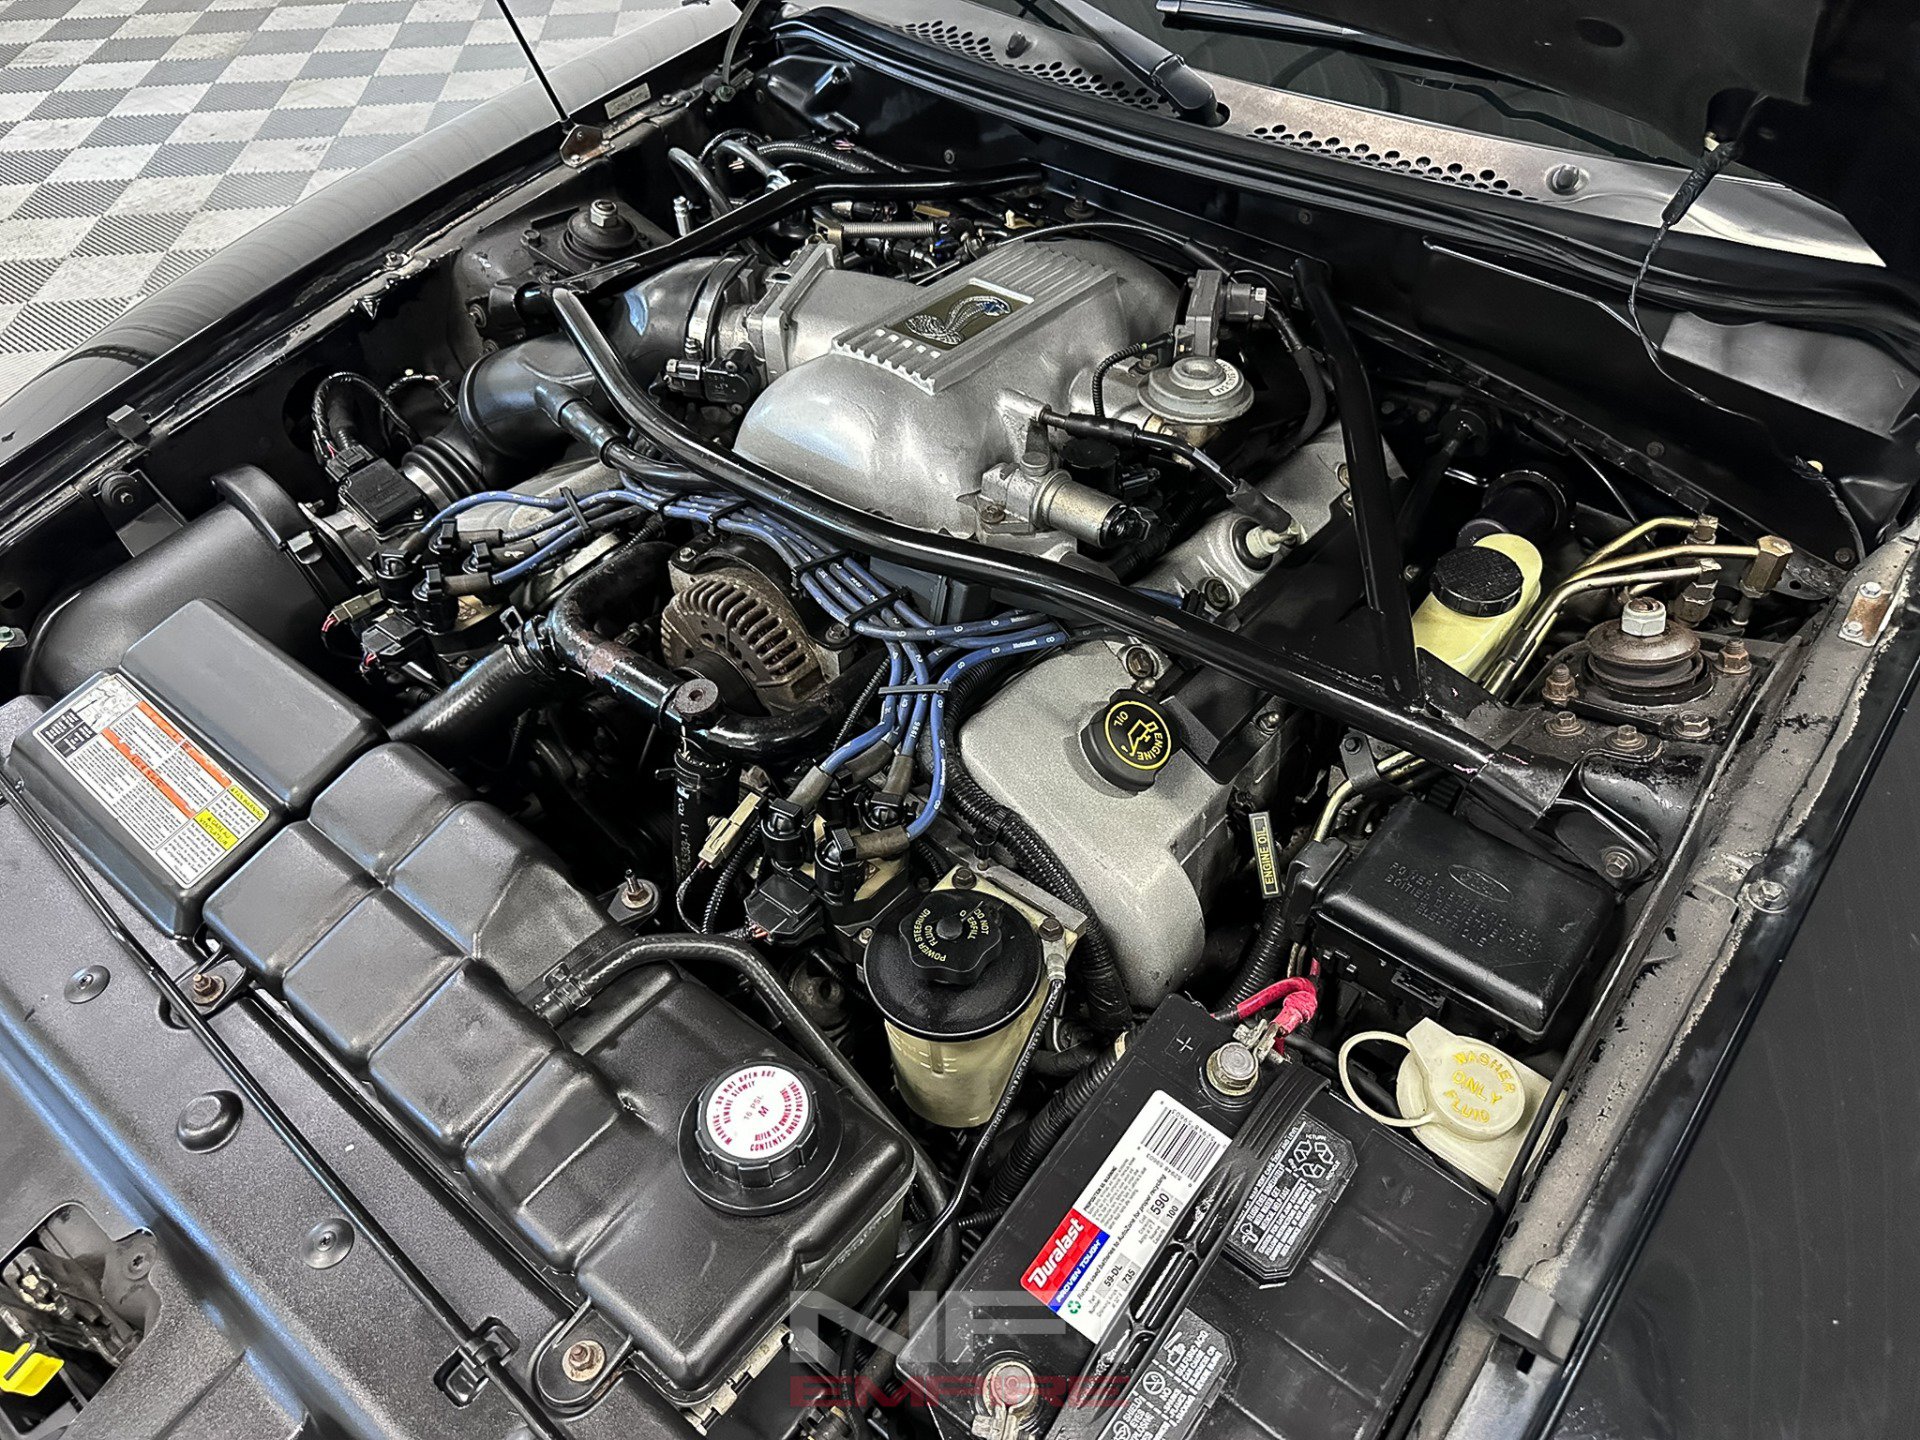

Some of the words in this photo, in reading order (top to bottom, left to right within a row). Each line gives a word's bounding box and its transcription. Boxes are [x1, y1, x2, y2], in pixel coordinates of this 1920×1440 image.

[1114, 711, 1129, 727] OIL
[1137, 732, 1163, 761] ENGINE
[1256, 826, 1268, 844] OIL
[1260, 846, 1274, 885] ENGINE
[913, 908, 931, 942] STEERING
[973, 908, 985, 920] DO
[980, 920, 990, 936] NOT
[924, 924, 938, 947] FLUID
[918, 943, 946, 962] POWER
[1453, 1051, 1515, 1093] WASHER
[788, 1081, 803, 1113] PRESSURE
[1452, 1070, 1503, 1105] ONLY
[743, 1111, 753, 1120] 16
[1443, 1089, 1490, 1123] FLUID
[785, 1113, 802, 1135] UNDER
[750, 1133, 787, 1152] CONTENTS
[1149, 1192, 1170, 1215] 590
[1166, 1204, 1179, 1219] 100
[1089, 1268, 1100, 1281] used
[1098, 1247, 1115, 1268] batteries
[1117, 1217, 1135, 1241] AutoZone
[1132, 1209, 1141, 1219] for
[1138, 1195, 1151, 1211] proper
[1149, 1174, 1166, 1195] recycling
[1028, 1218, 1084, 1289] Duralast
[1055, 1268, 1081, 1302] PROVEN
[1080, 1240, 1100, 1267] TOUGH
[1103, 1263, 1122, 1286] 59-DL
[1122, 1269, 1135, 1284] 735
[1175, 1344, 1198, 1376] SULFURIC
[1193, 1329, 1208, 1347] ACID
[1205, 1344, 1217, 1357] OR
[1182, 1367, 1193, 1381] CAN
[1189, 1349, 1204, 1368] CAUSE
[1159, 1386, 1172, 1401] NO
[1122, 1397, 1142, 1422] SHIELD
[1129, 1408, 1145, 1428] EYES
[1129, 1412, 1154, 1440] PLOSIVE
